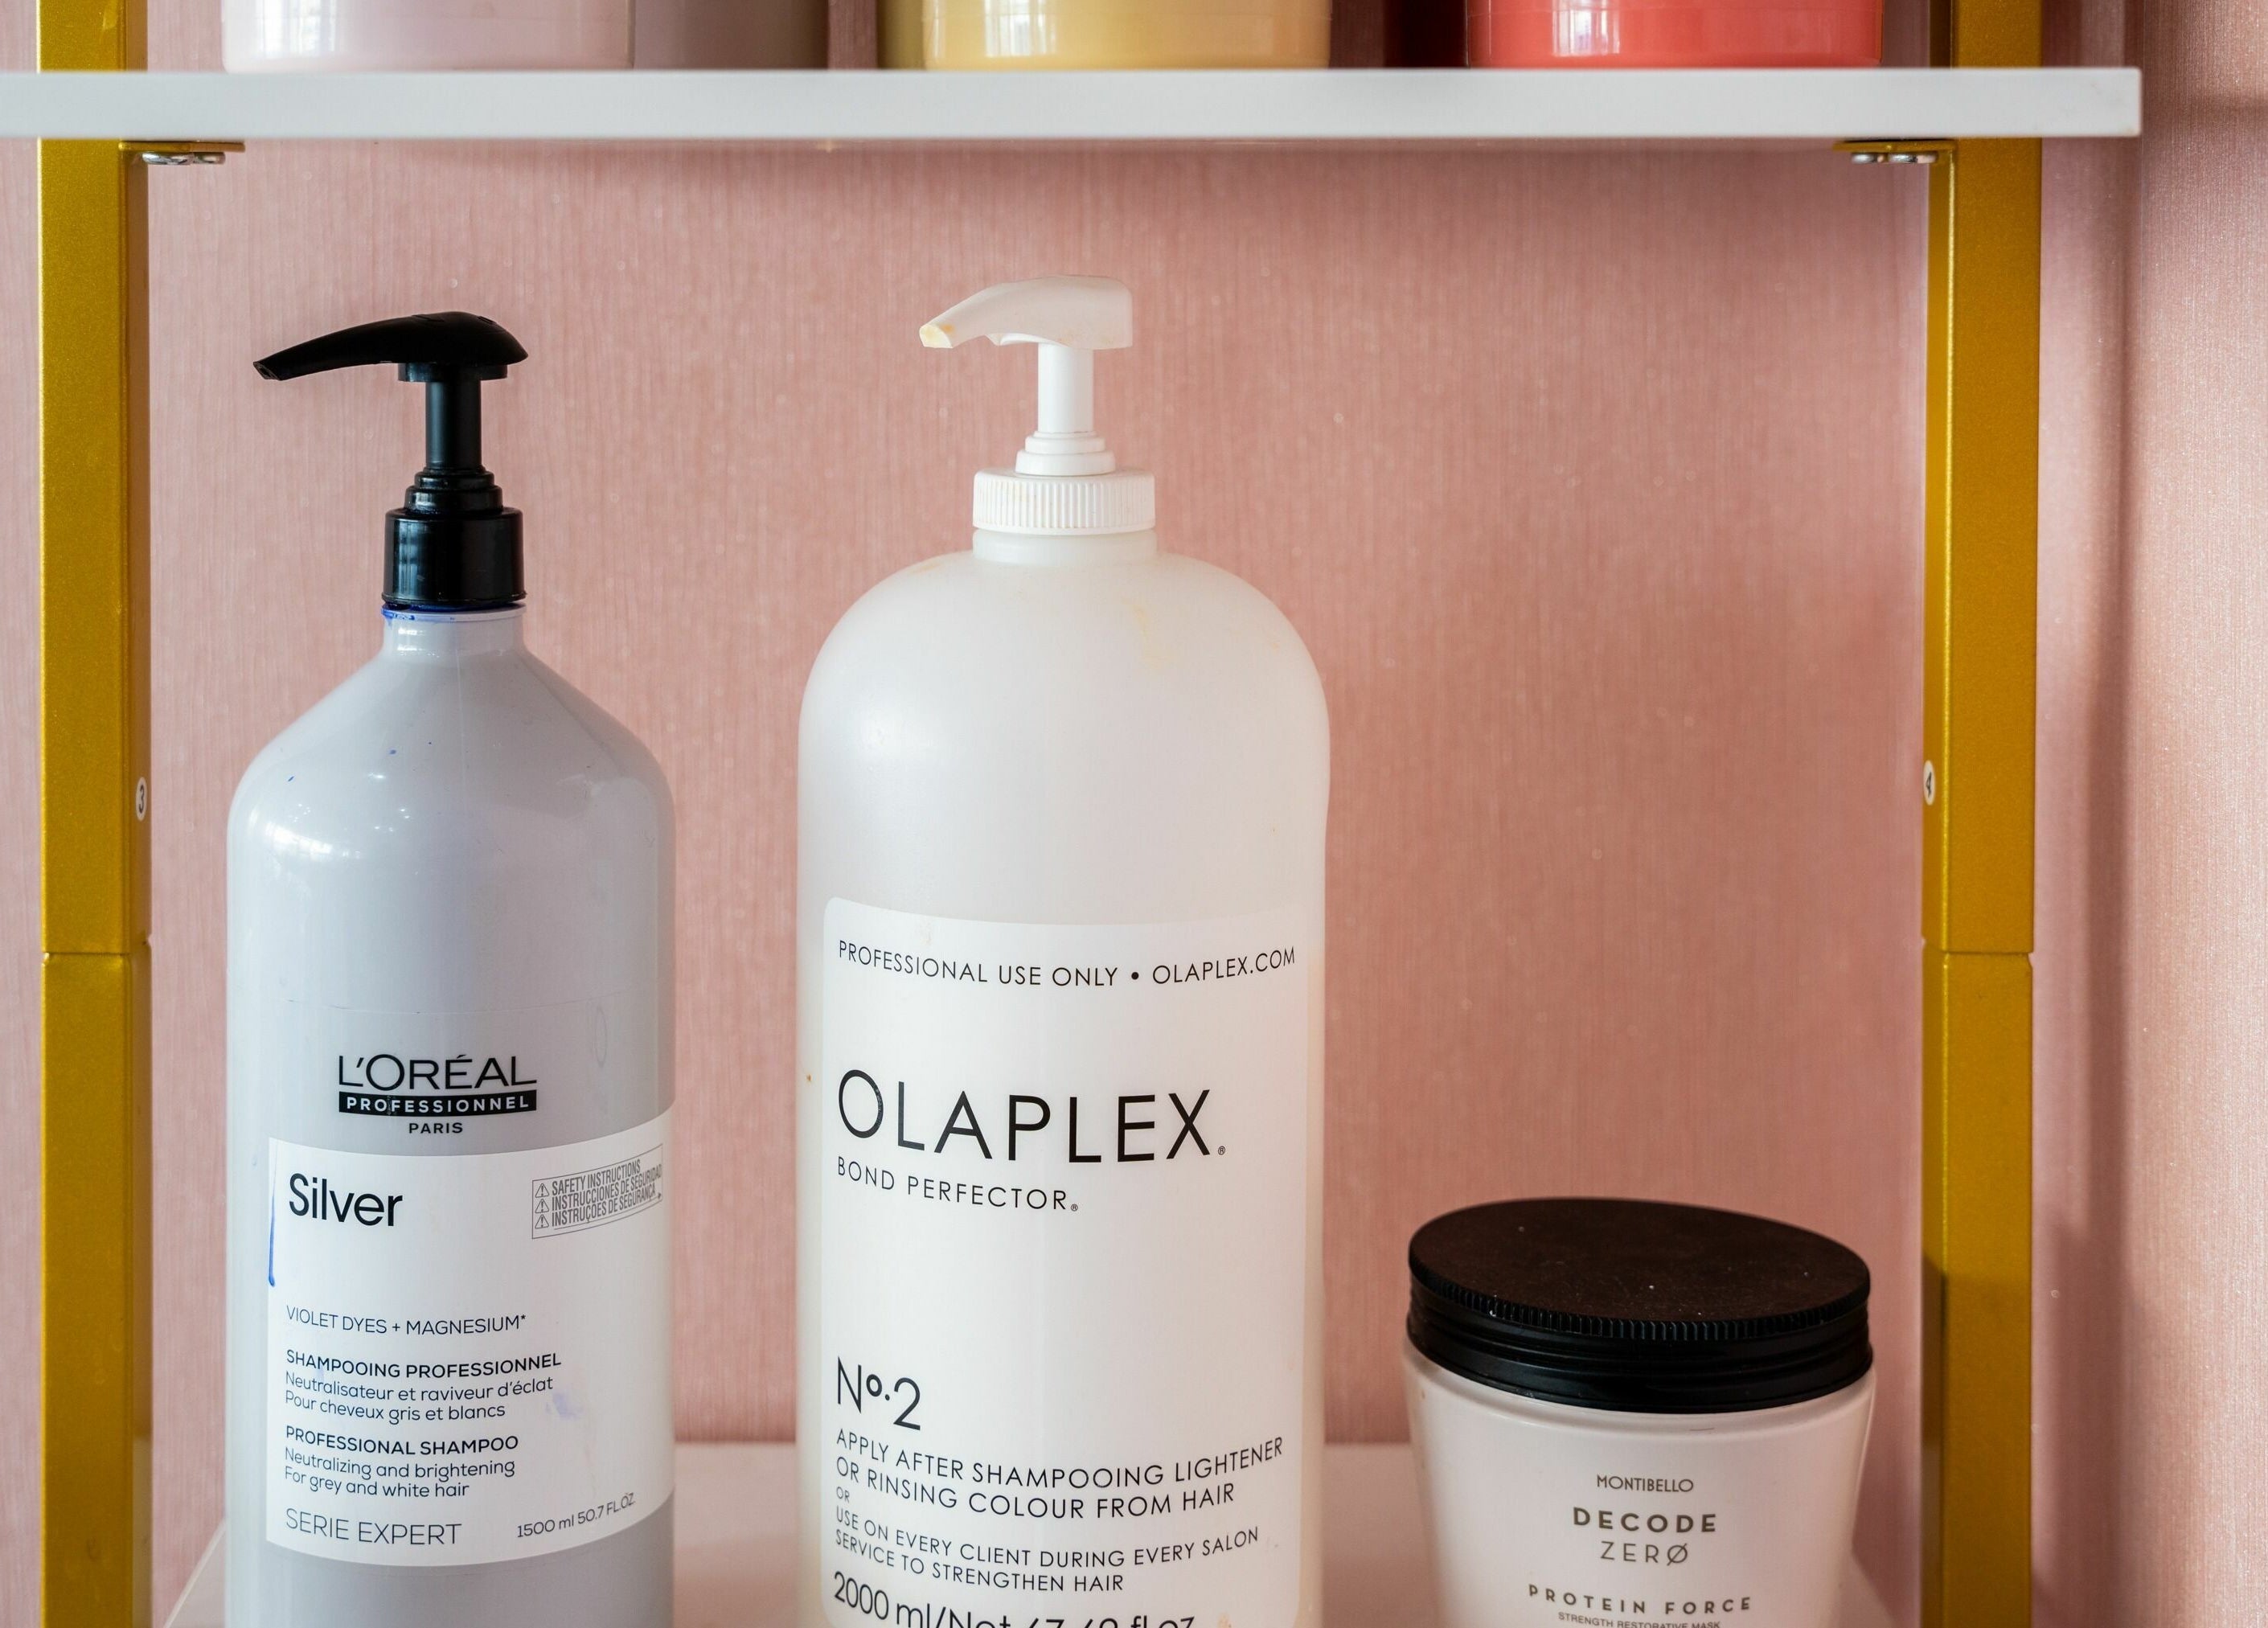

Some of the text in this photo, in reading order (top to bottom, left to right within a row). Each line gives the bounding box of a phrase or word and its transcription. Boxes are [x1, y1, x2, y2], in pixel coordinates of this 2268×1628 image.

[839, 940, 1295, 986] PROFESSIONAL USE ONLY OLAPLEX.COM
[338, 1054, 537, 1091] L'ORÉAL
[347, 1096, 529, 1113] PROFESSIONNEL
[408, 1122, 463, 1134] PARIS
[552, 1158, 641, 1196] SAFETY INSTRUCTIONS
[838, 1156, 895, 1190] BOND
[289, 1173, 403, 1227] Silver
[552, 1182, 619, 1212] INSTRUCCIONES
[621, 1179, 630, 1195] DE
[608, 1197, 618, 1214] DE
[286, 1306, 338, 1329] VIOLET
[342, 1316, 388, 1334] DYES
[286, 1349, 561, 1378] SHAMPOOING PROFESSIONNEL
[285, 1371, 553, 1401] Neutralisateur et raviveur d'éclat
[285, 1390, 506, 1425] Pour cheveux gris et blancs
[286, 1425, 519, 1455] PROFESSIONAL SHAMPOO
[285, 1447, 515, 1482] Neutralizing and brightening
[837, 1429, 1282, 1489] APPLY AFTER SHAMPOOING LIGHTENER
[285, 1466, 470, 1497] For grey and white hair
[836, 1486, 850, 1503] OR
[837, 1457, 1234, 1519] OR RINSING COLOUR FROM HAIR
[1597, 1474, 1694, 1492] MONTIBELLO
[286, 1508, 462, 1545] SERIE EXPERT
[517, 1519, 556, 1537] 1500
[559, 1514, 574, 1529] ml
[577, 1505, 605, 1524] 50.7
[1573, 1507, 1716, 1533] DECODE
[836, 1505, 1258, 1568] USE ON EVERY CLIENT DURING EVERY SALON
[835, 1528, 1123, 1592] SERVICE TO STRENGTHEN HAIR
[1600, 1540, 1688, 1566] ZERØ
[835, 1571, 889, 1621] 2000
[1528, 1584, 1751, 1615] PROTEIN FORCE
[1558, 1612, 1613, 1627] STRENGTH
